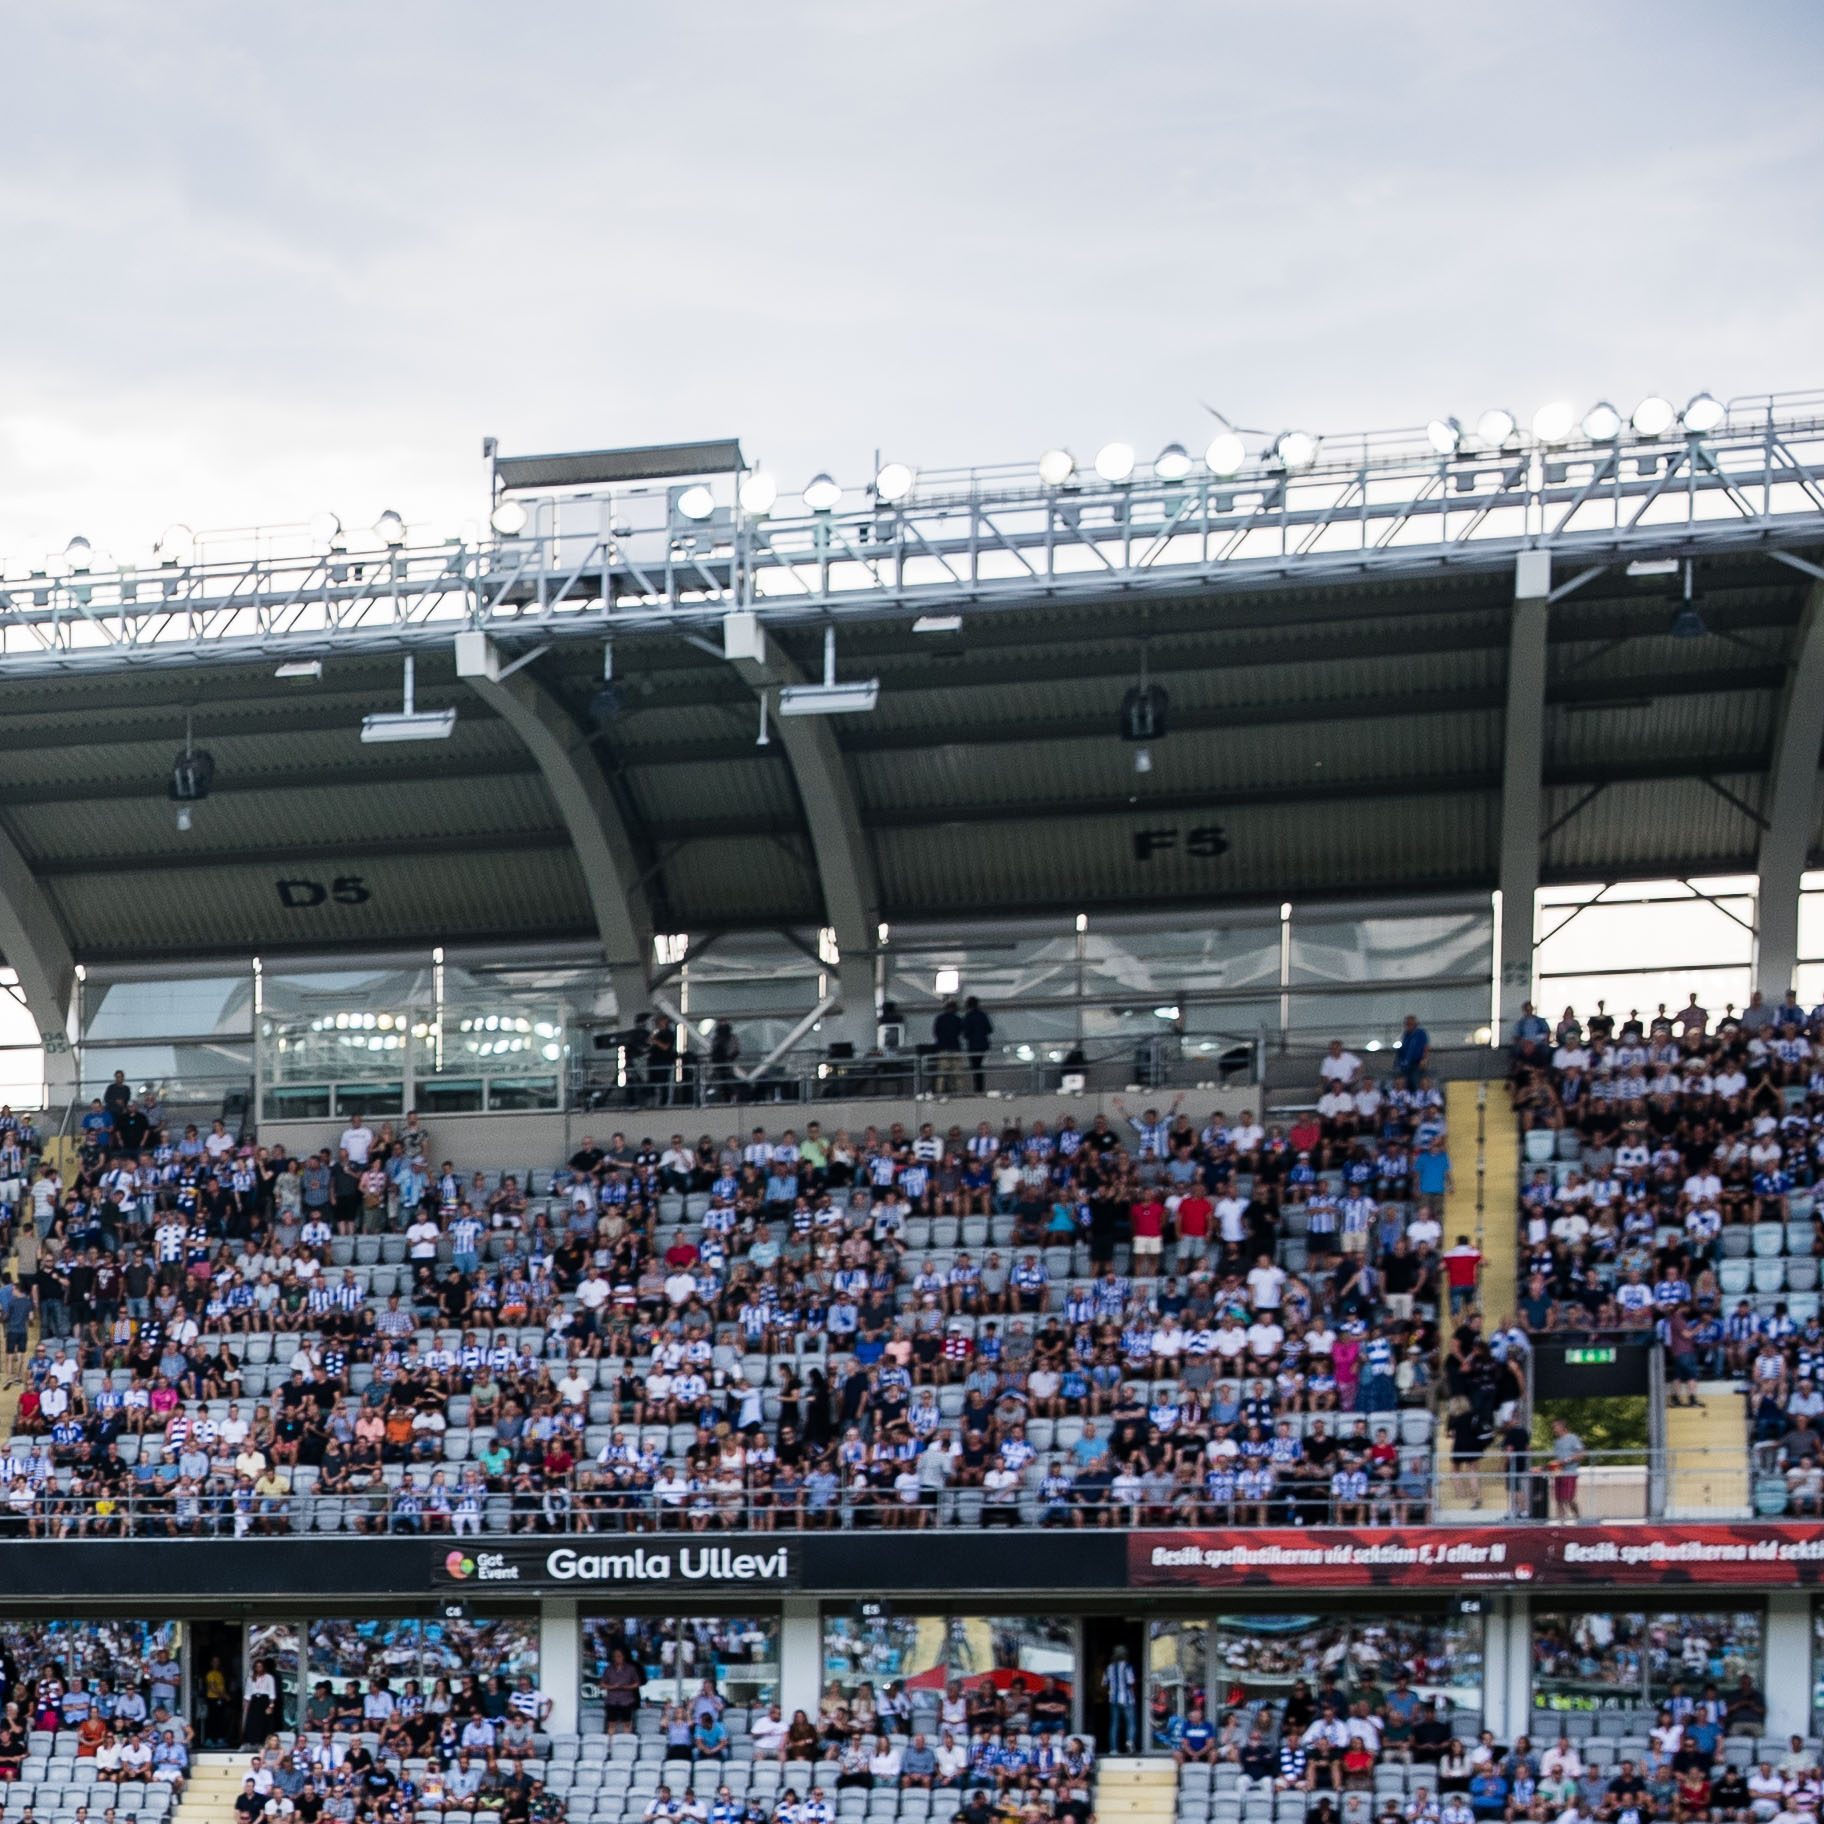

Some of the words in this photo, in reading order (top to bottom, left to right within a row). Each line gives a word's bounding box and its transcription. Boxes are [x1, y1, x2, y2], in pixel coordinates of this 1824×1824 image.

[1132, 827, 1231, 860] F5
[275, 877, 372, 909] D5
[477, 1553, 504, 1568] Got
[477, 1566, 519, 1580] Event
[547, 1549, 671, 1579] Gamla
[679, 1548, 788, 1578] Ullevi
